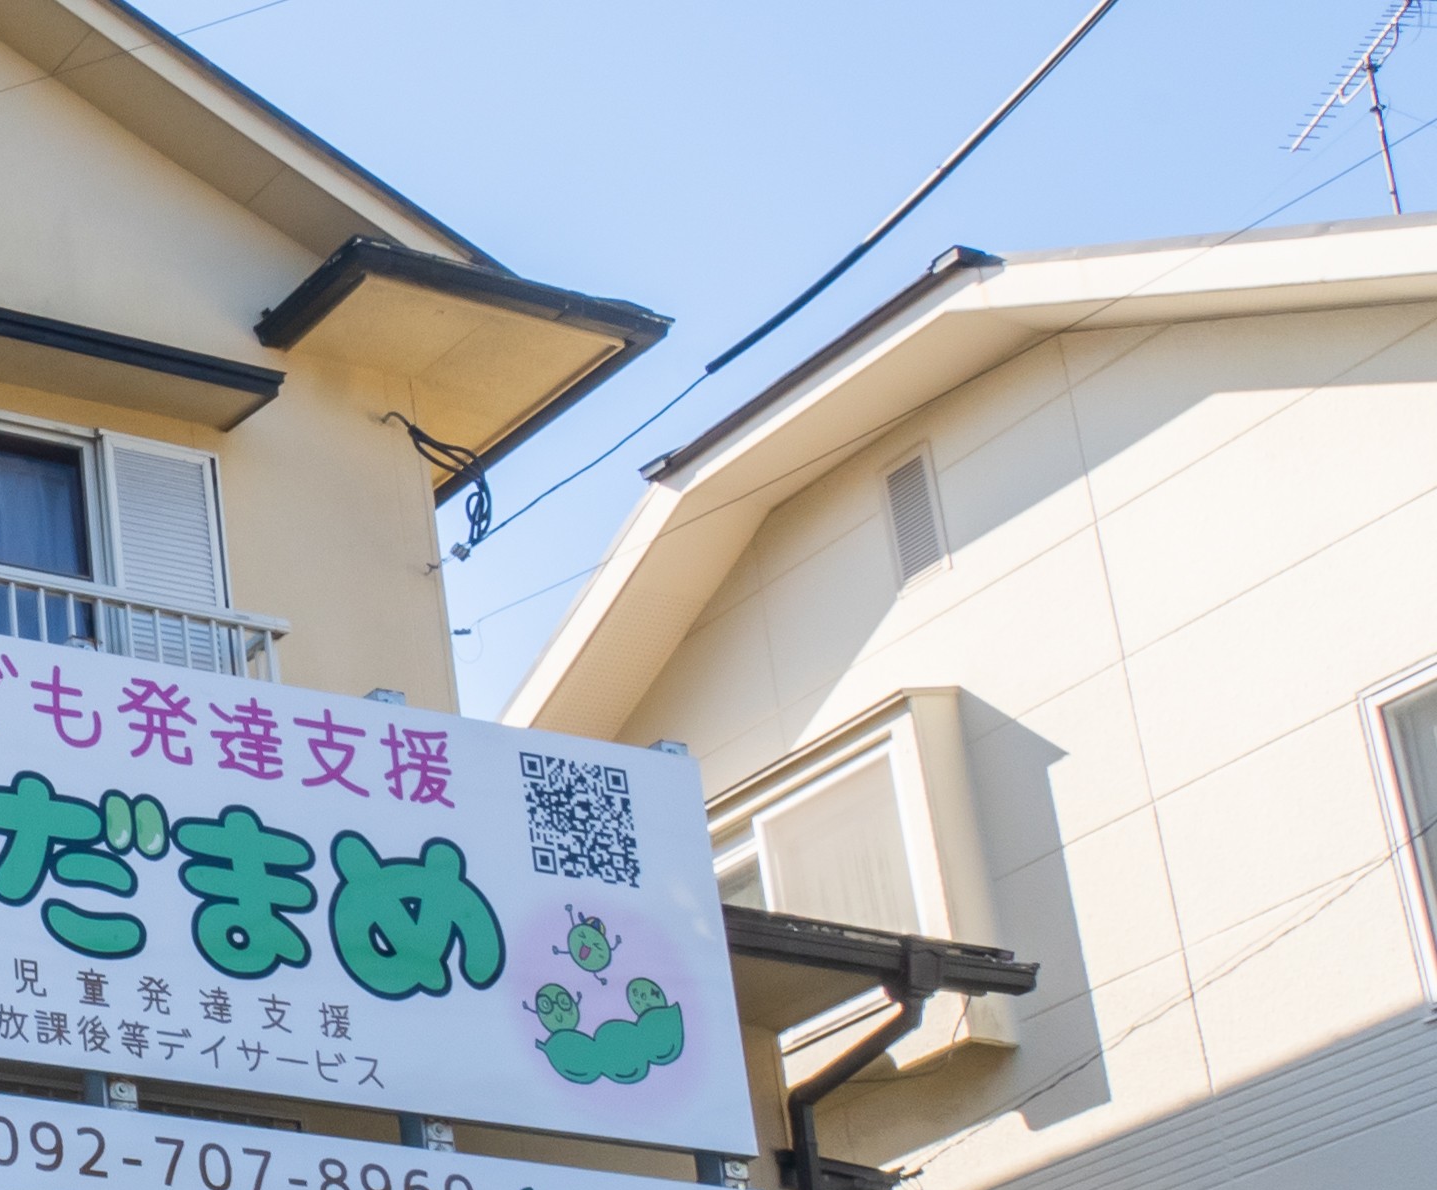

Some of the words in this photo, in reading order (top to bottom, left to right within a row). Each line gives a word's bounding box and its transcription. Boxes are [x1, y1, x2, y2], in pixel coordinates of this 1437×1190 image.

[14, 958, 353, 1041] 児童発達支援
